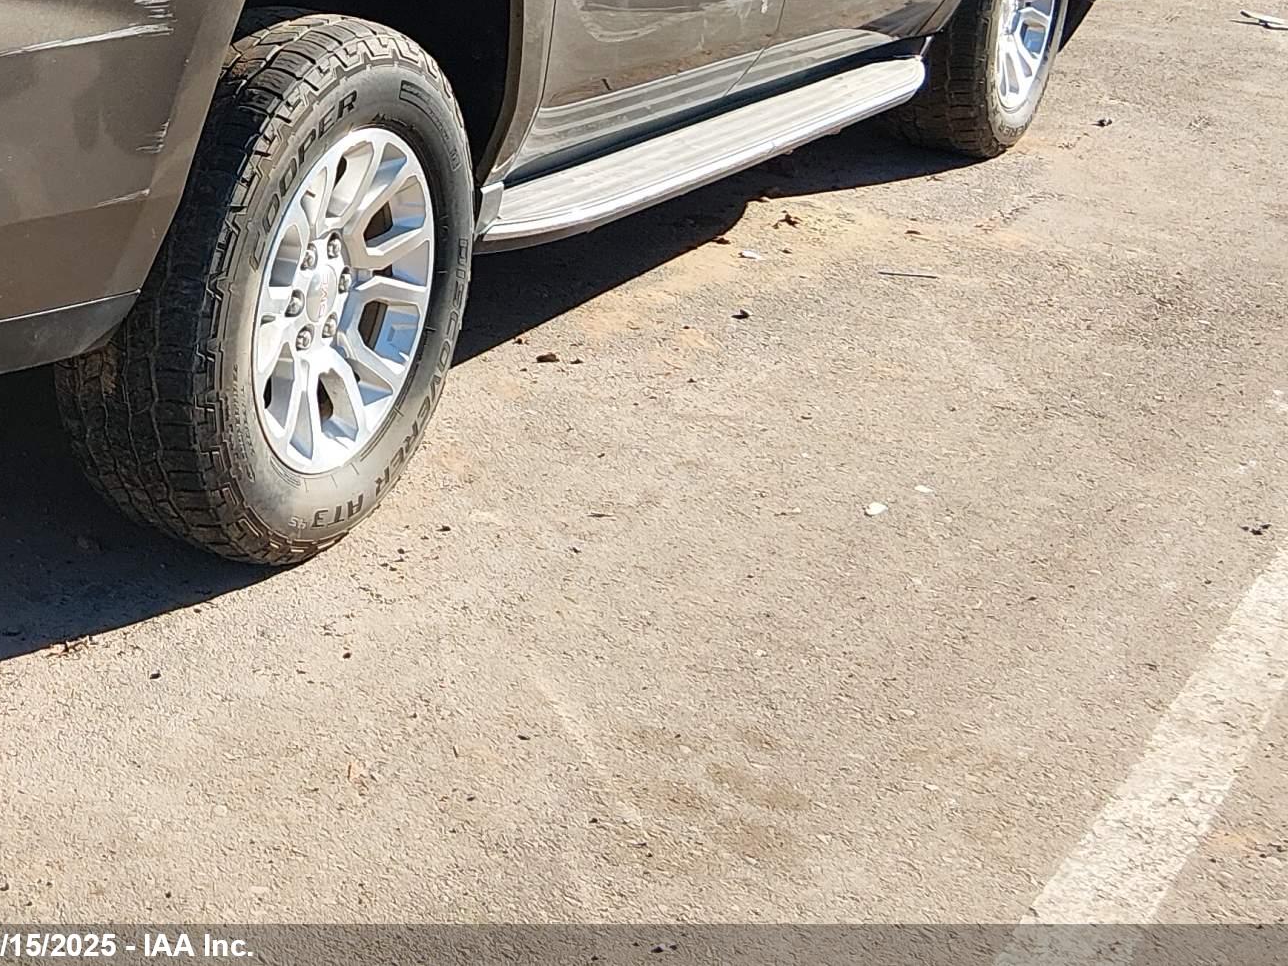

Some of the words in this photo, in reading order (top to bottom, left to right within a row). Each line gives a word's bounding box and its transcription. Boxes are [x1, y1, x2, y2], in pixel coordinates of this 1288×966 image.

[249, 89, 358, 273] COOPER
[375, 236, 470, 498] DISCOVERER
[311, 492, 364, 529] AT3
